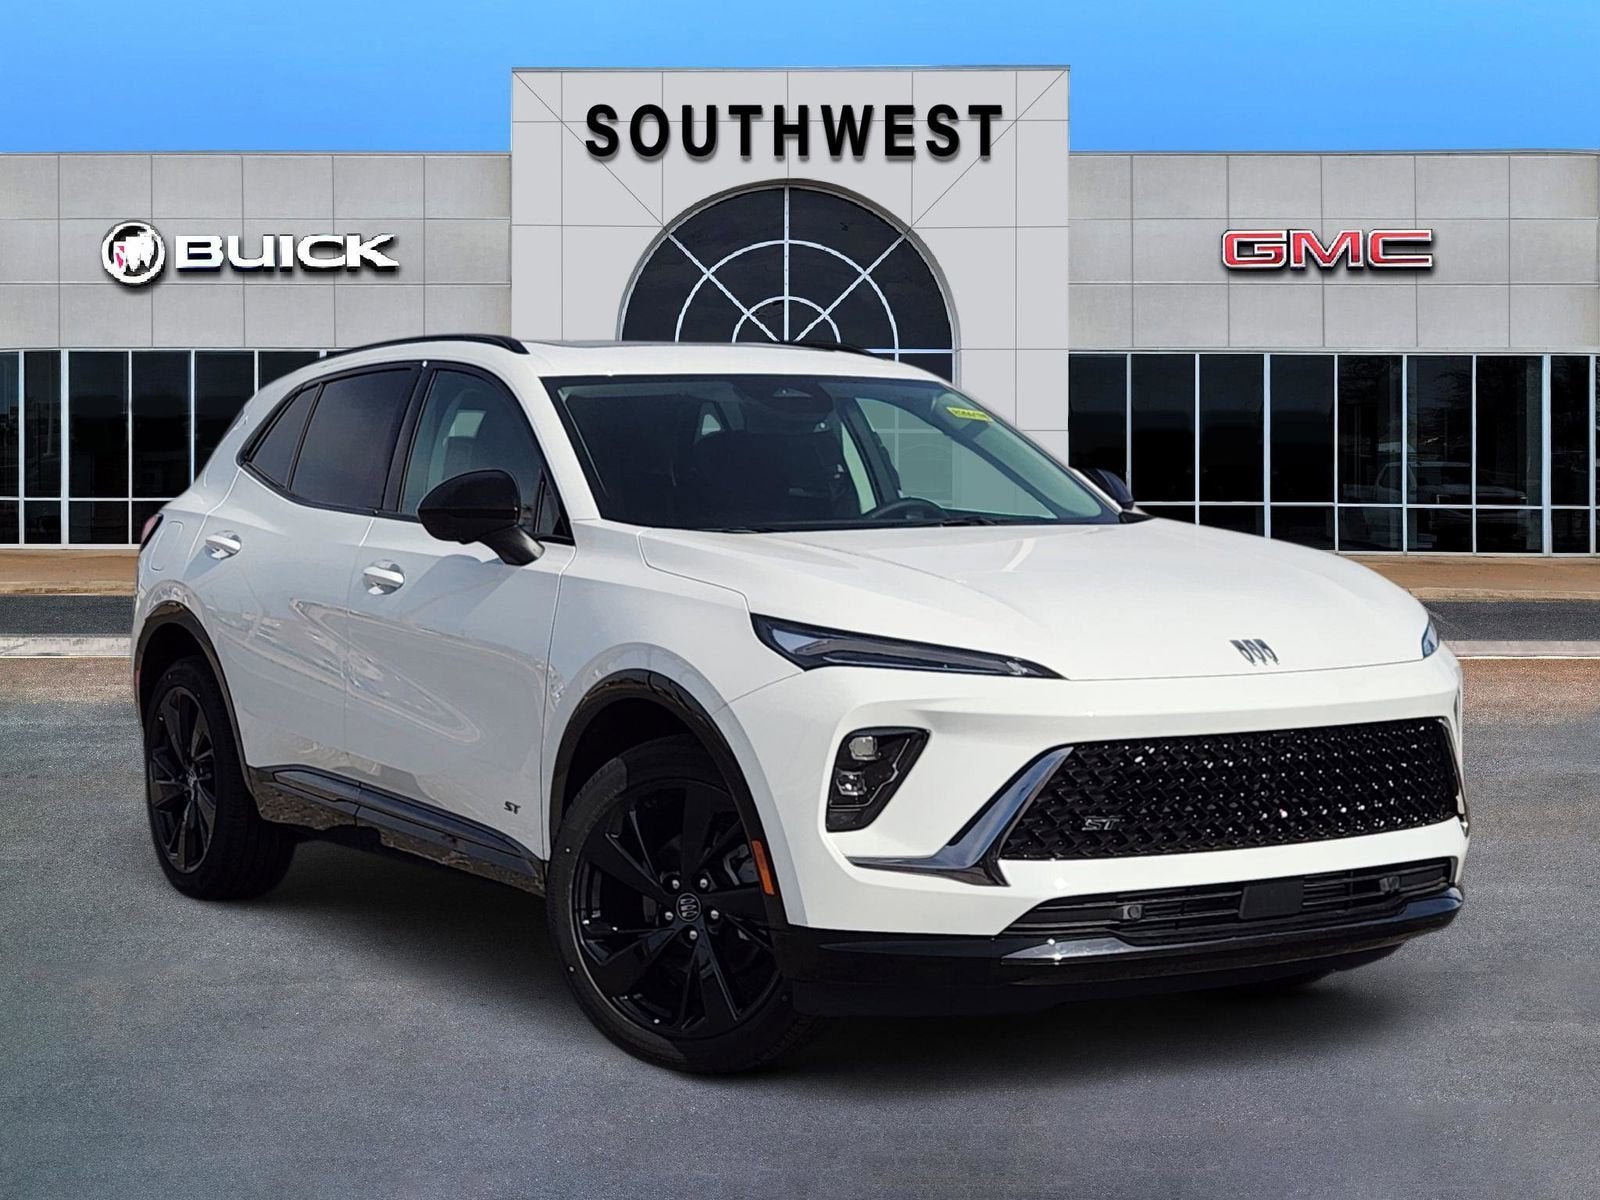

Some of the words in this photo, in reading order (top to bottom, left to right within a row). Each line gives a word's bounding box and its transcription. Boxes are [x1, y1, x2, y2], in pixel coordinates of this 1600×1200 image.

[585, 104, 1002, 157] SOUTHWEST
[175, 234, 400, 270] BUICK
[1222, 230, 1432, 269] GMC
[504, 801, 521, 814] ST
[1081, 816, 1121, 831] ST
